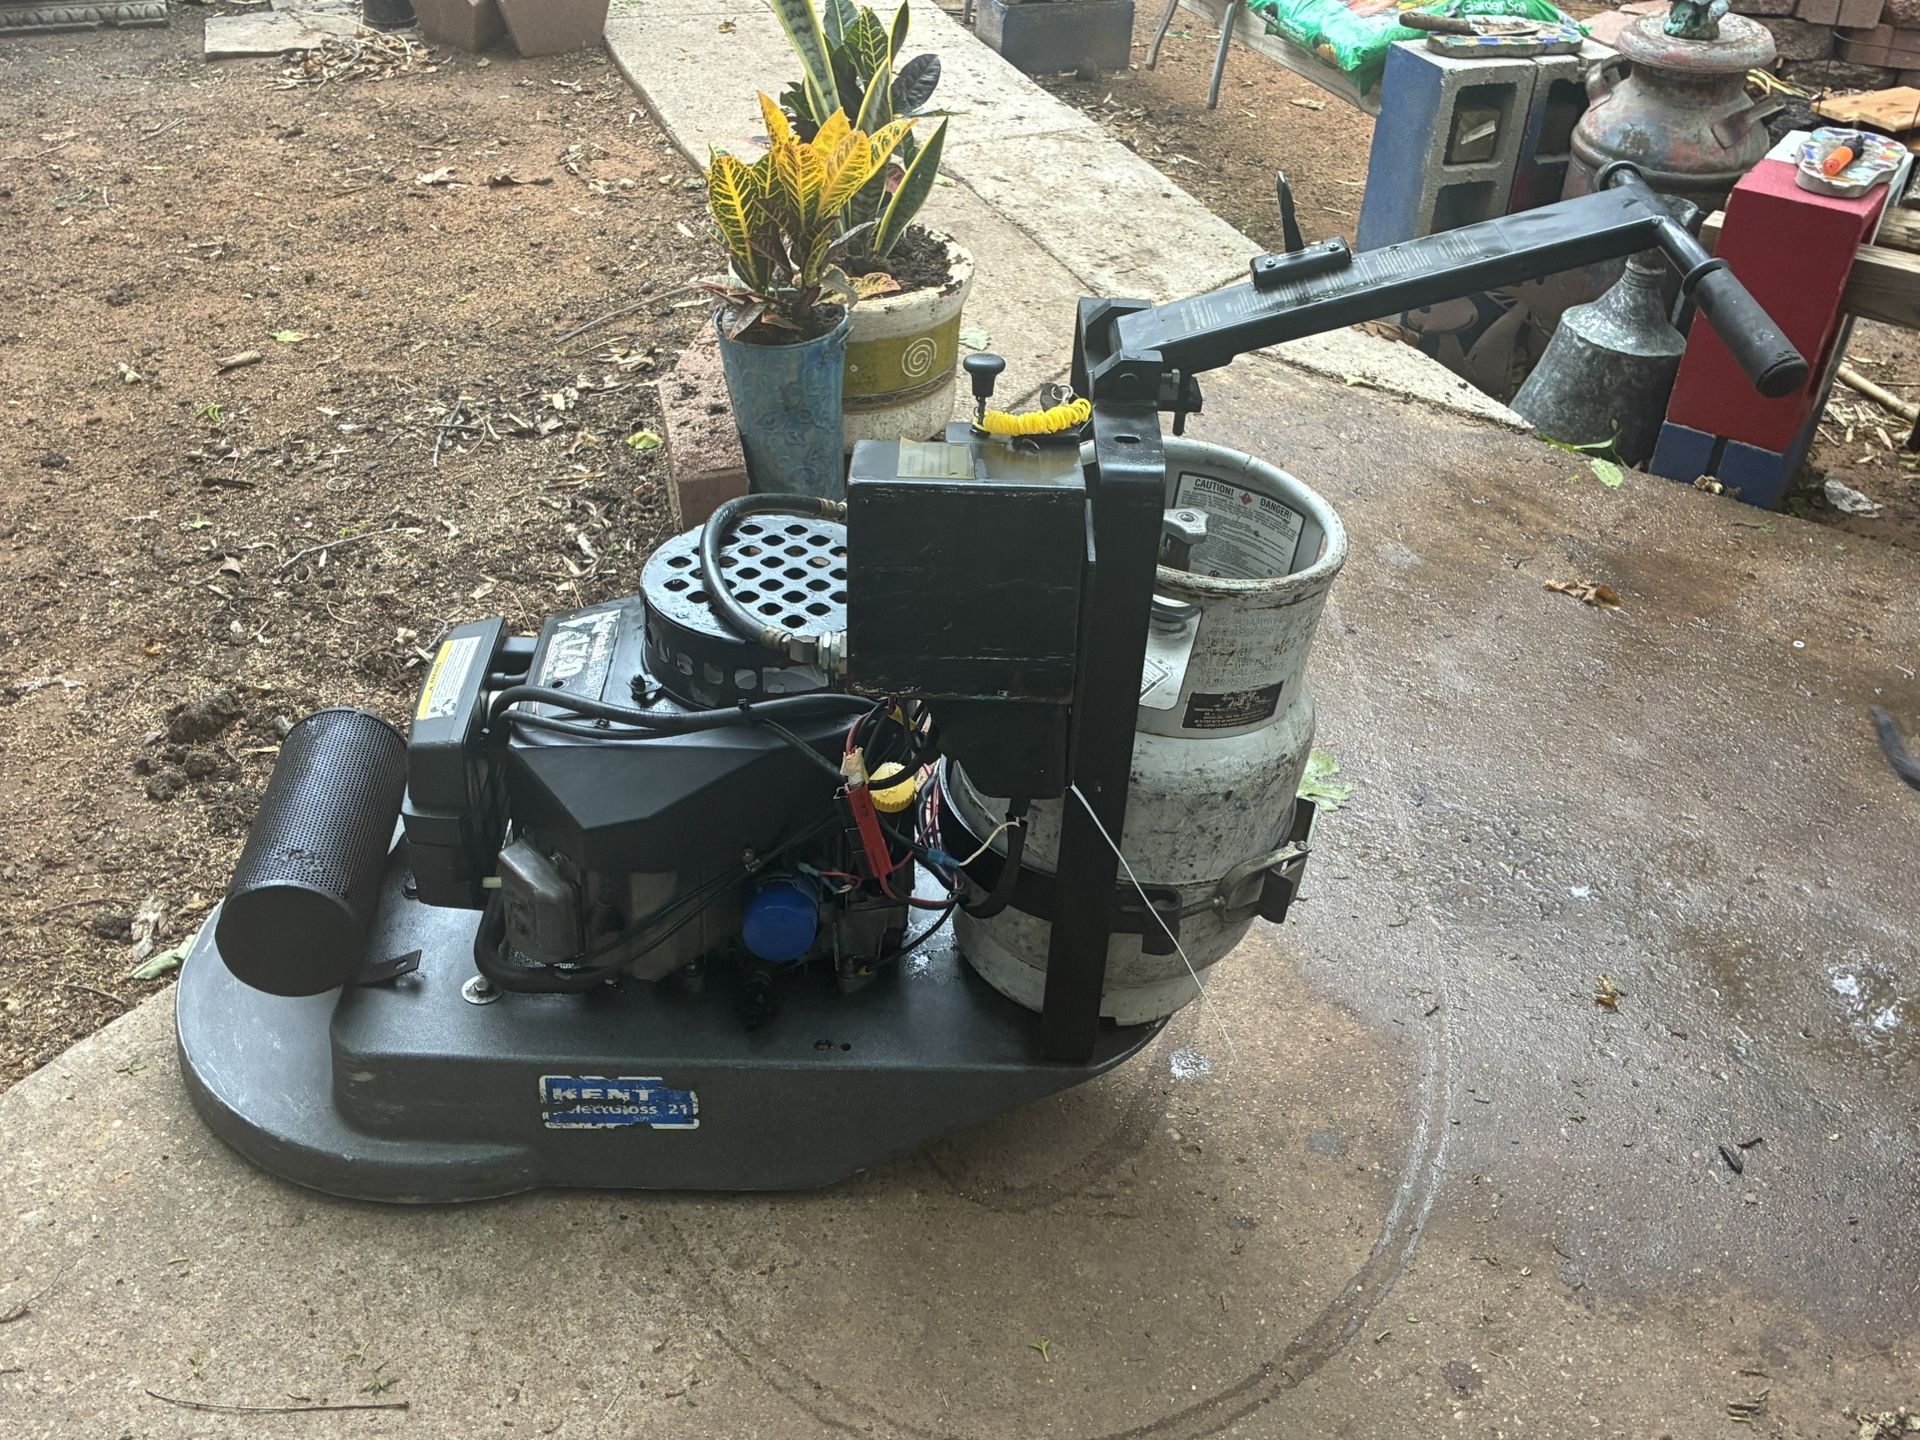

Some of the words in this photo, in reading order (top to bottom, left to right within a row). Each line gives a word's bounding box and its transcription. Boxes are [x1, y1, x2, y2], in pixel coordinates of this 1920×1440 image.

[1462, 0, 1505, 14] Garden
[1194, 478, 1235, 497] CAUTION!
[1260, 498, 1293, 520] DANGER!
[552, 1088, 655, 1101] KENT
[668, 1104, 688, 1115] 21
